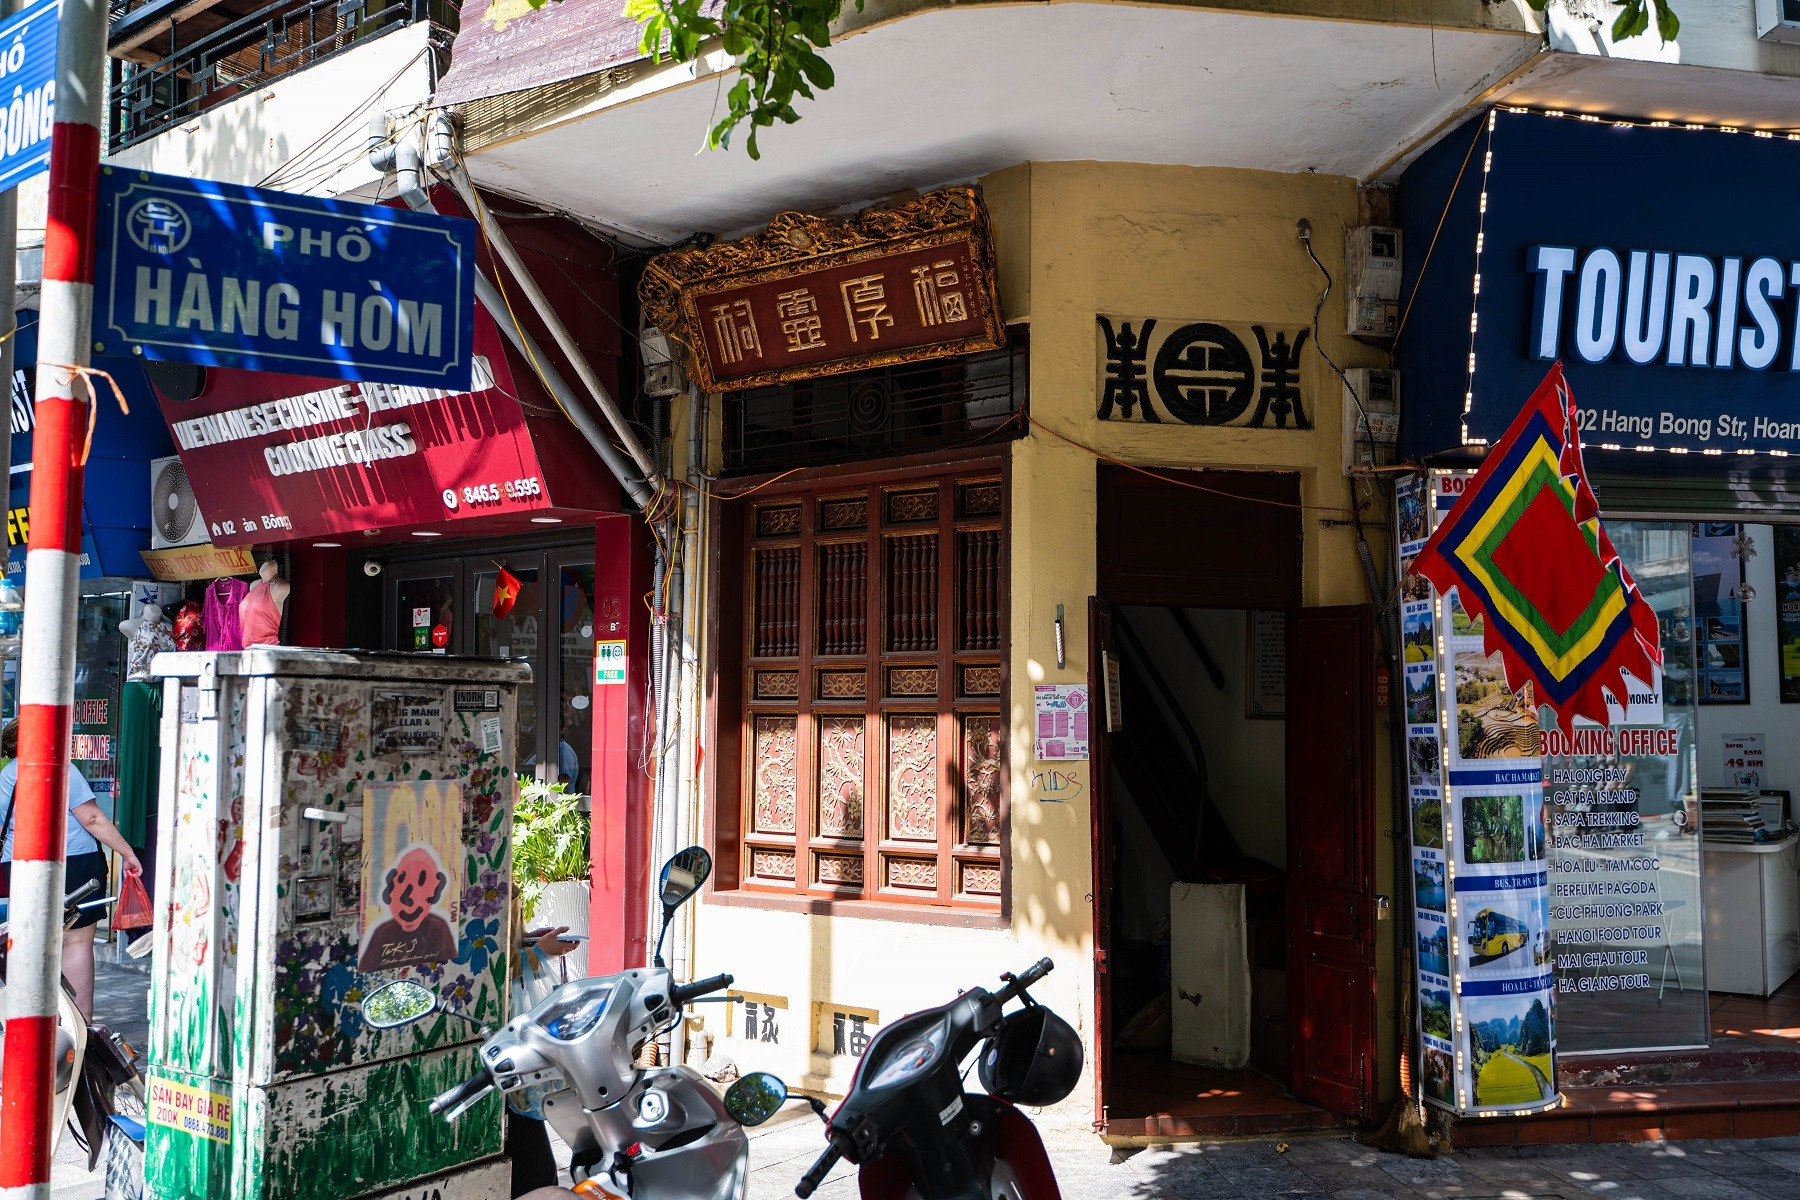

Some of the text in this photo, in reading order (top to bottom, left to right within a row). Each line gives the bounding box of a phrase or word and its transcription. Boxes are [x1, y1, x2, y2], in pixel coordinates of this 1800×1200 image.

[263, 222, 378, 262] PHỐ
[134, 257, 442, 358] HÀNG HÒM
[172, 402, 279, 450] VIETNAMESE
[274, 383, 359, 430] CUISINE
[1601, 409, 1653, 439] Hang
[1659, 412, 1711, 441] Bong
[1716, 414, 1748, 441] Str,
[264, 422, 414, 477] COOKING CLASS
[603, 670, 618, 679] FREE
[81, 699, 107, 724] OFFICE
[1619, 729, 1679, 756] OFFICE
[1554, 768, 1627, 783] HALONG BAY
[1554, 789, 1636, 805] CAT BA ISLAND
[1555, 812, 1639, 827] SAPA TREKKING
[1556, 833, 1644, 849] BAC HA MARKET
[1554, 860, 1580, 874] HOA
[1582, 860, 1596, 872] LU
[1606, 859, 1630, 872] TAM
[1632, 858, 1660, 871] COC
[1556, 881, 1656, 898] PERFUME PAGODA
[1556, 902, 1664, 920] CUC PHUONG PARK
[1558, 926, 1661, 944] HANOI FOOD TOUR
[1558, 951, 1647, 969] MAI CHAU TOUR
[1502, 982, 1518, 992] HOA
[1559, 974, 1650, 994] HA GIANG TOUR
[175, 1092, 194, 1111] BAY
[197, 1096, 213, 1117] GIÁ
[156, 1106, 179, 1125] 200K
